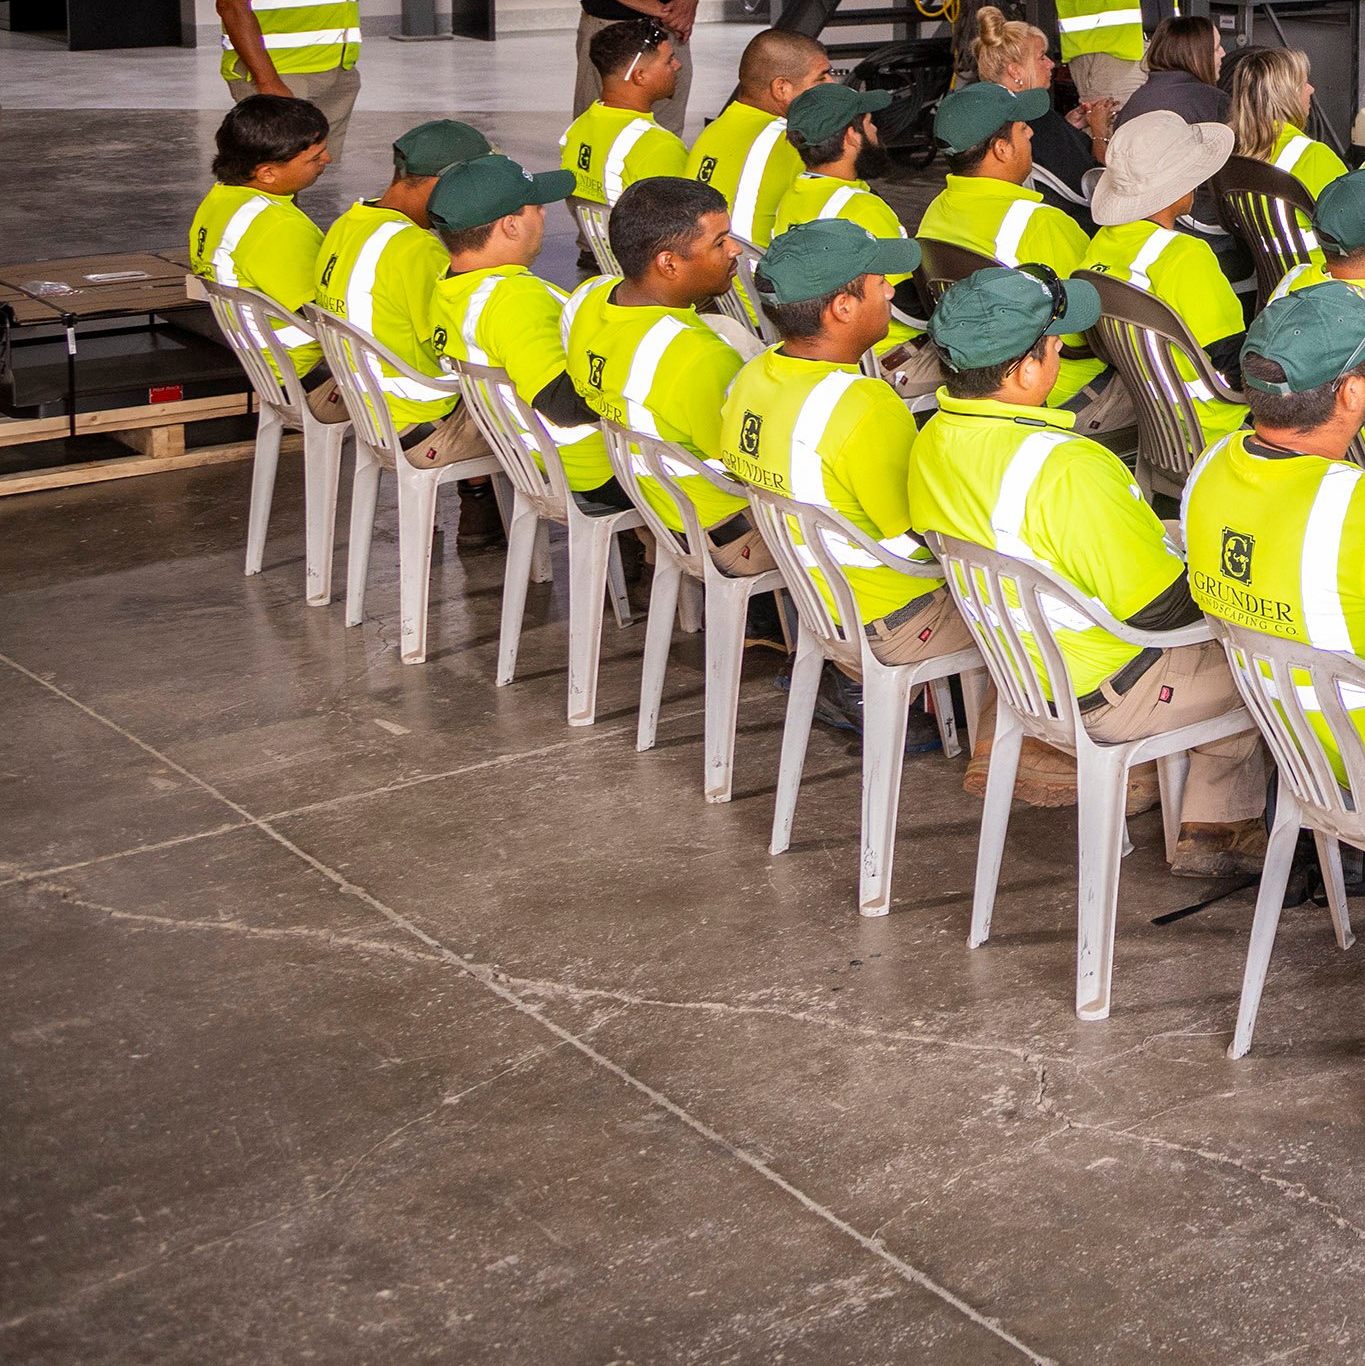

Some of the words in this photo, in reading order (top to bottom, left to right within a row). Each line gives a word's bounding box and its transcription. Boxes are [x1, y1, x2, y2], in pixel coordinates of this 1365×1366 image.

[722, 450, 786, 491] GRUNDER
[1193, 571, 1294, 623] GRUNDER
[1194, 591, 1269, 631] LANDSCAPING
